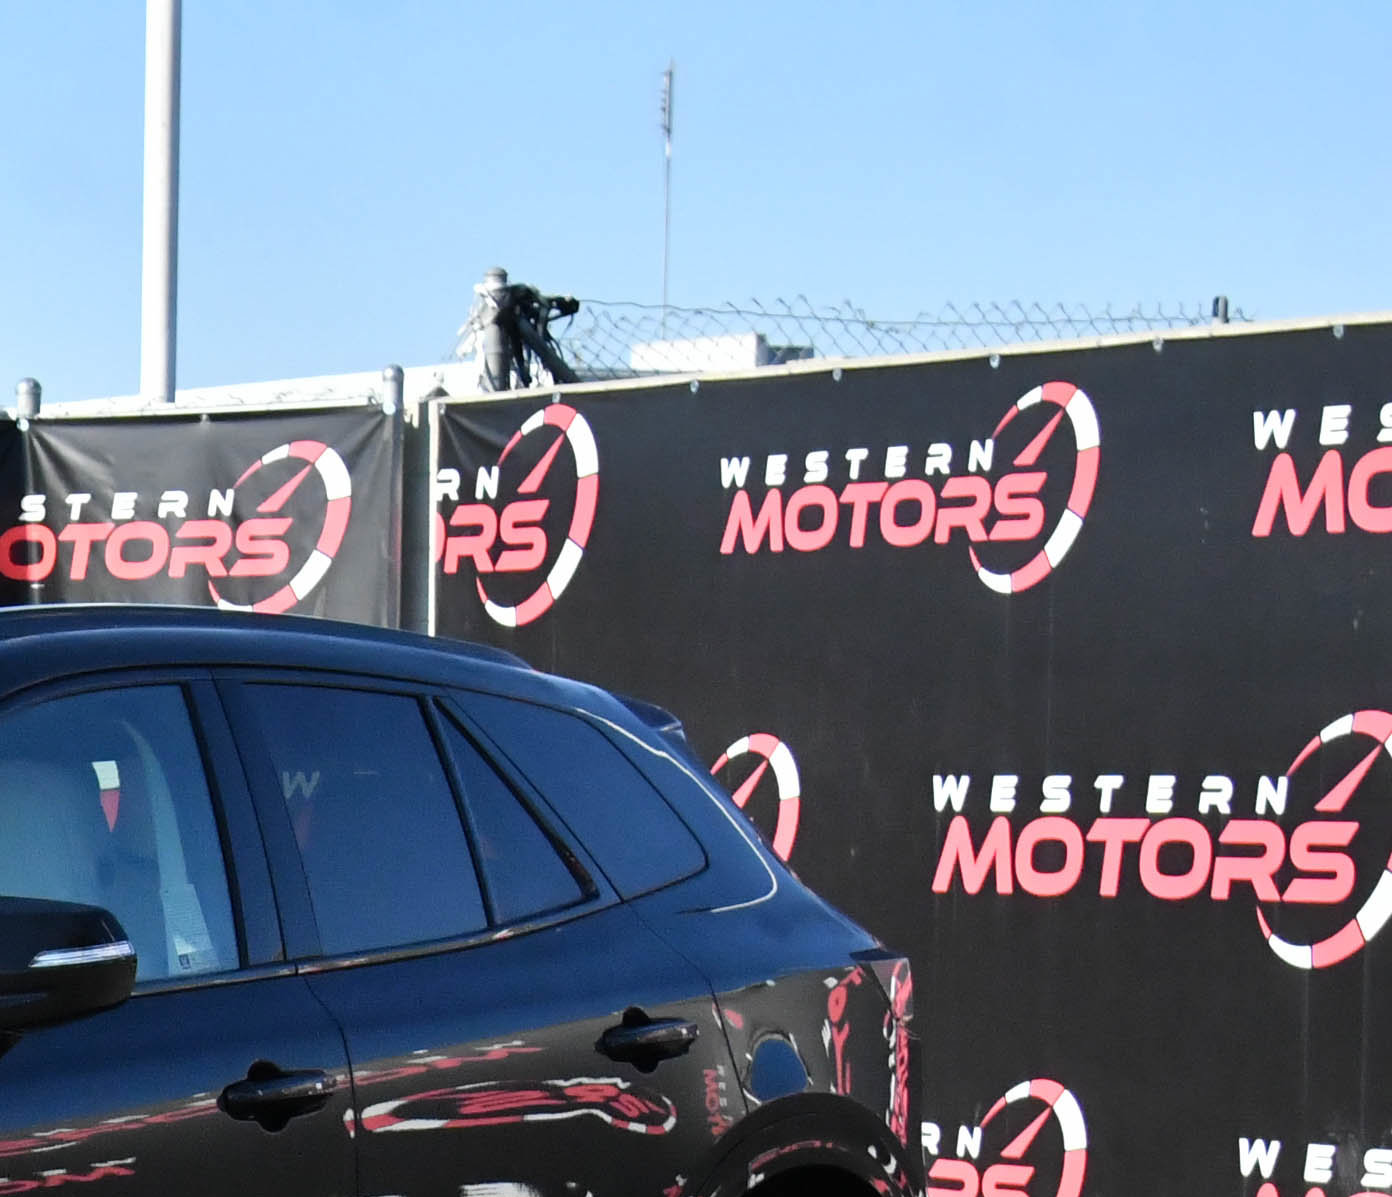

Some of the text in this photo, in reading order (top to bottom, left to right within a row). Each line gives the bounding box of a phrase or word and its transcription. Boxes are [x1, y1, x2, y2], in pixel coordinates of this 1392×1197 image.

[721, 438, 994, 489] WESTERN
[437, 500, 550, 574] RS
[720, 472, 1048, 555] MOTORS
[932, 773, 1289, 815] WESTERN
[931, 816, 1360, 904] MOTORS
